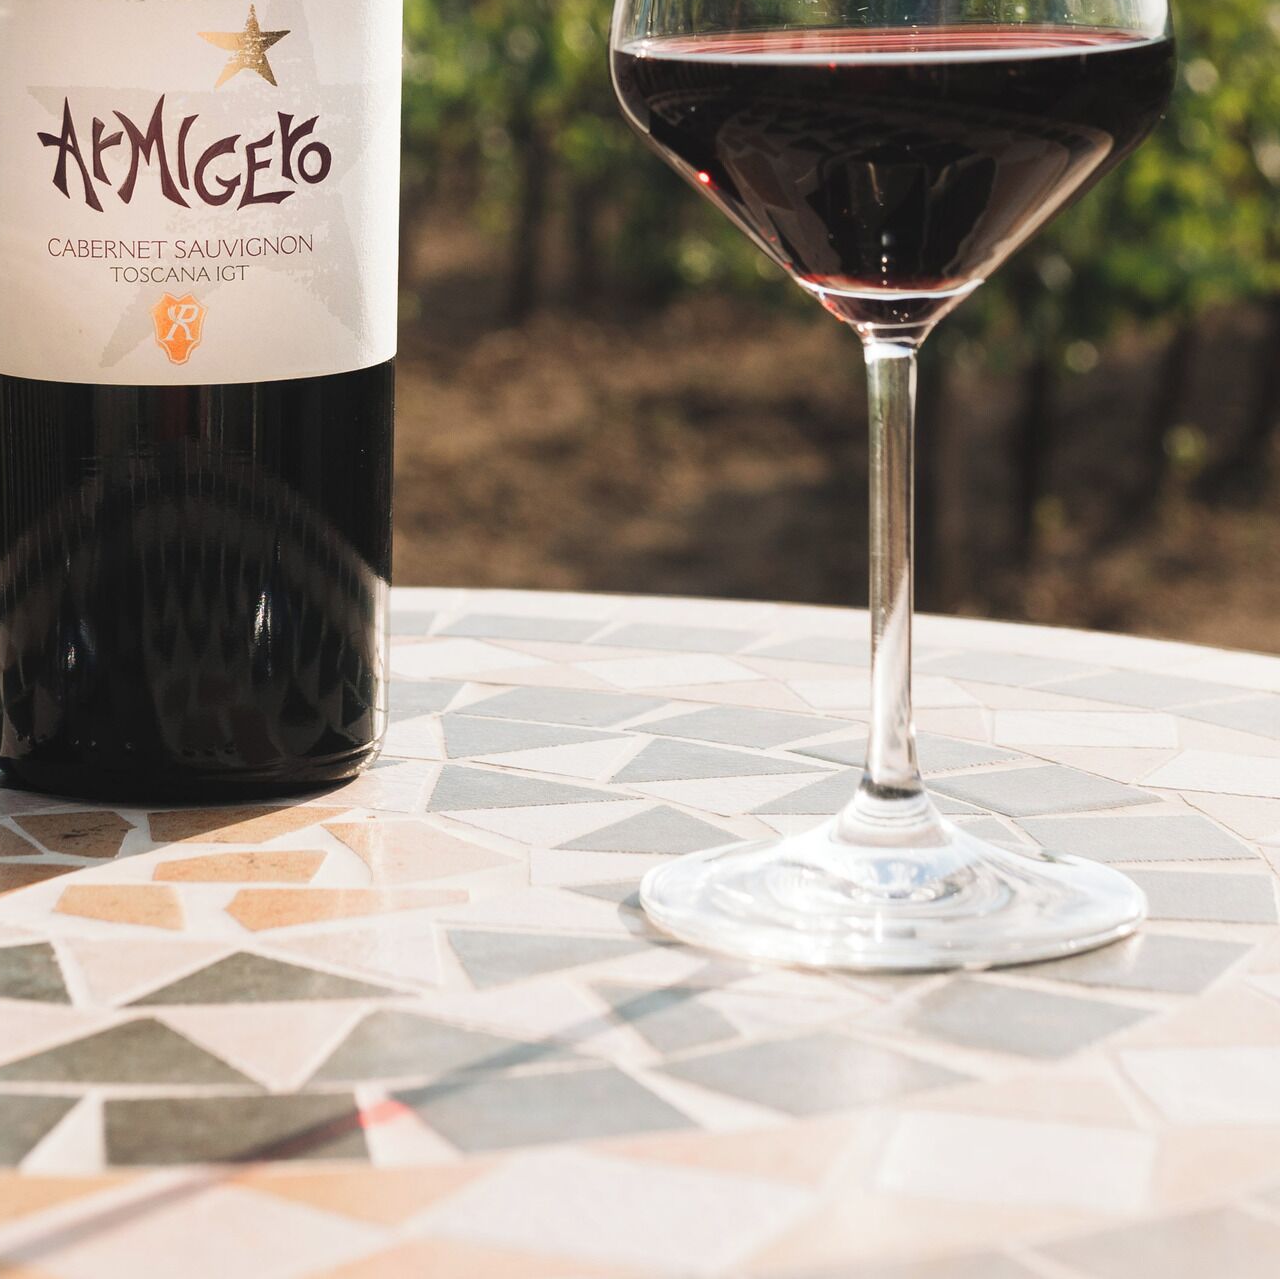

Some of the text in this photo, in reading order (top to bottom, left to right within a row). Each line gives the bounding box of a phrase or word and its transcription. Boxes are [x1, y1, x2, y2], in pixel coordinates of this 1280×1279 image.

[47, 234, 313, 259] CABERNET SAUVIGNON
[110, 264, 250, 284] TOSCANA IGT
